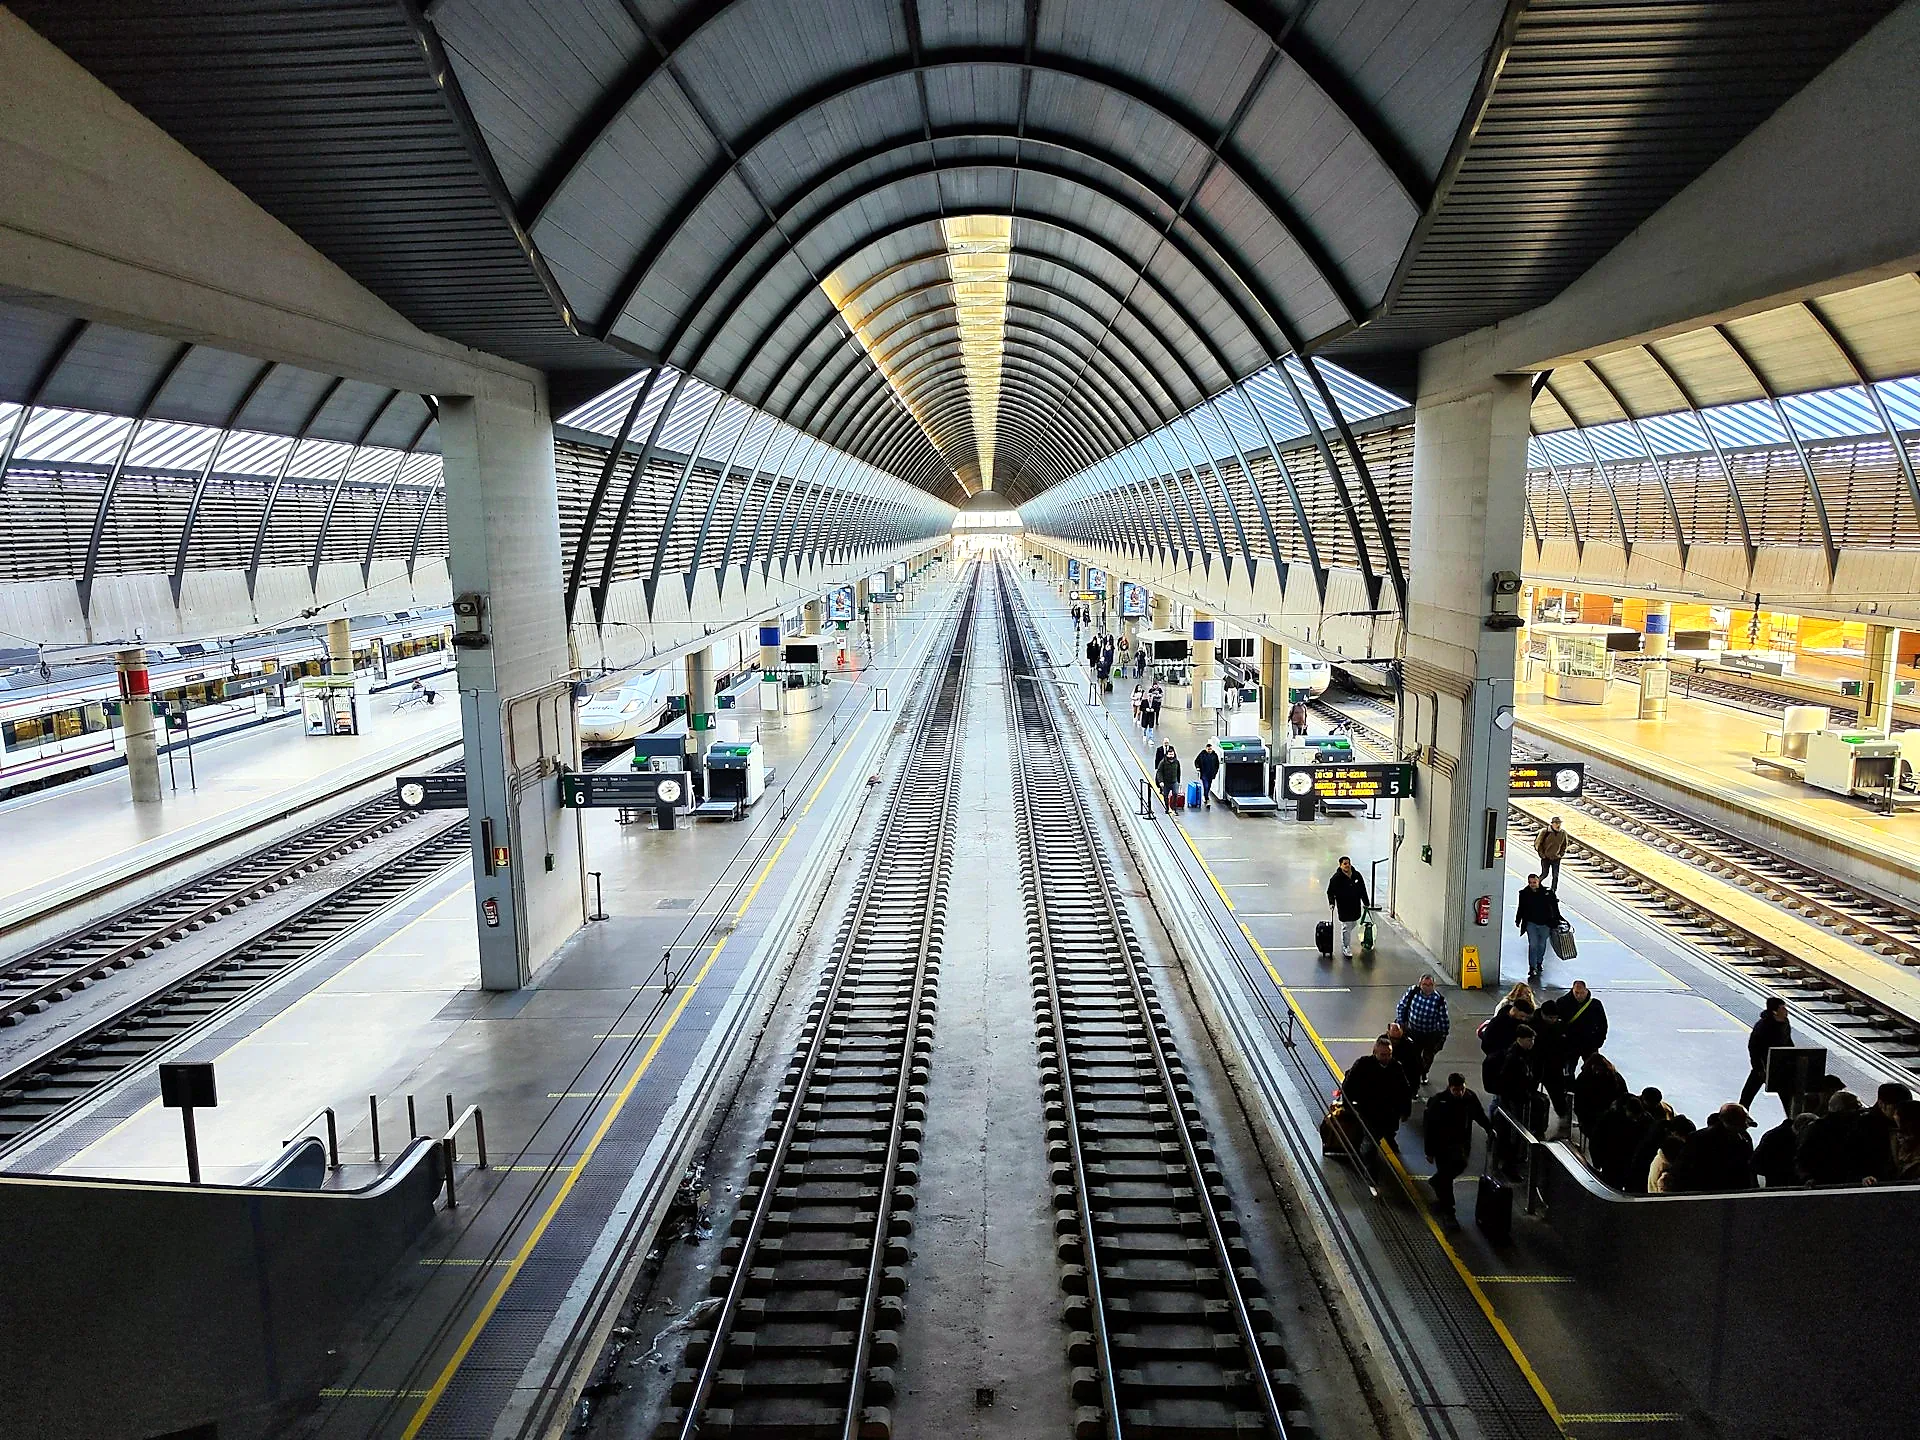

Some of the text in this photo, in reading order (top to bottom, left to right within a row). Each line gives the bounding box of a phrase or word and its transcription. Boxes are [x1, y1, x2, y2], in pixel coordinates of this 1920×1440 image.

[1841, 687, 1847, 695] 3
[1908, 687, 1915, 695] 2
[1239, 695, 1244, 703] 5
[730, 701, 735, 709] 6
[103, 708, 109, 716] 9
[165, 707, 170, 715] 8
[707, 714, 716, 728] A
[1390, 781, 1400, 795] 5
[575, 791, 586, 805] 6
